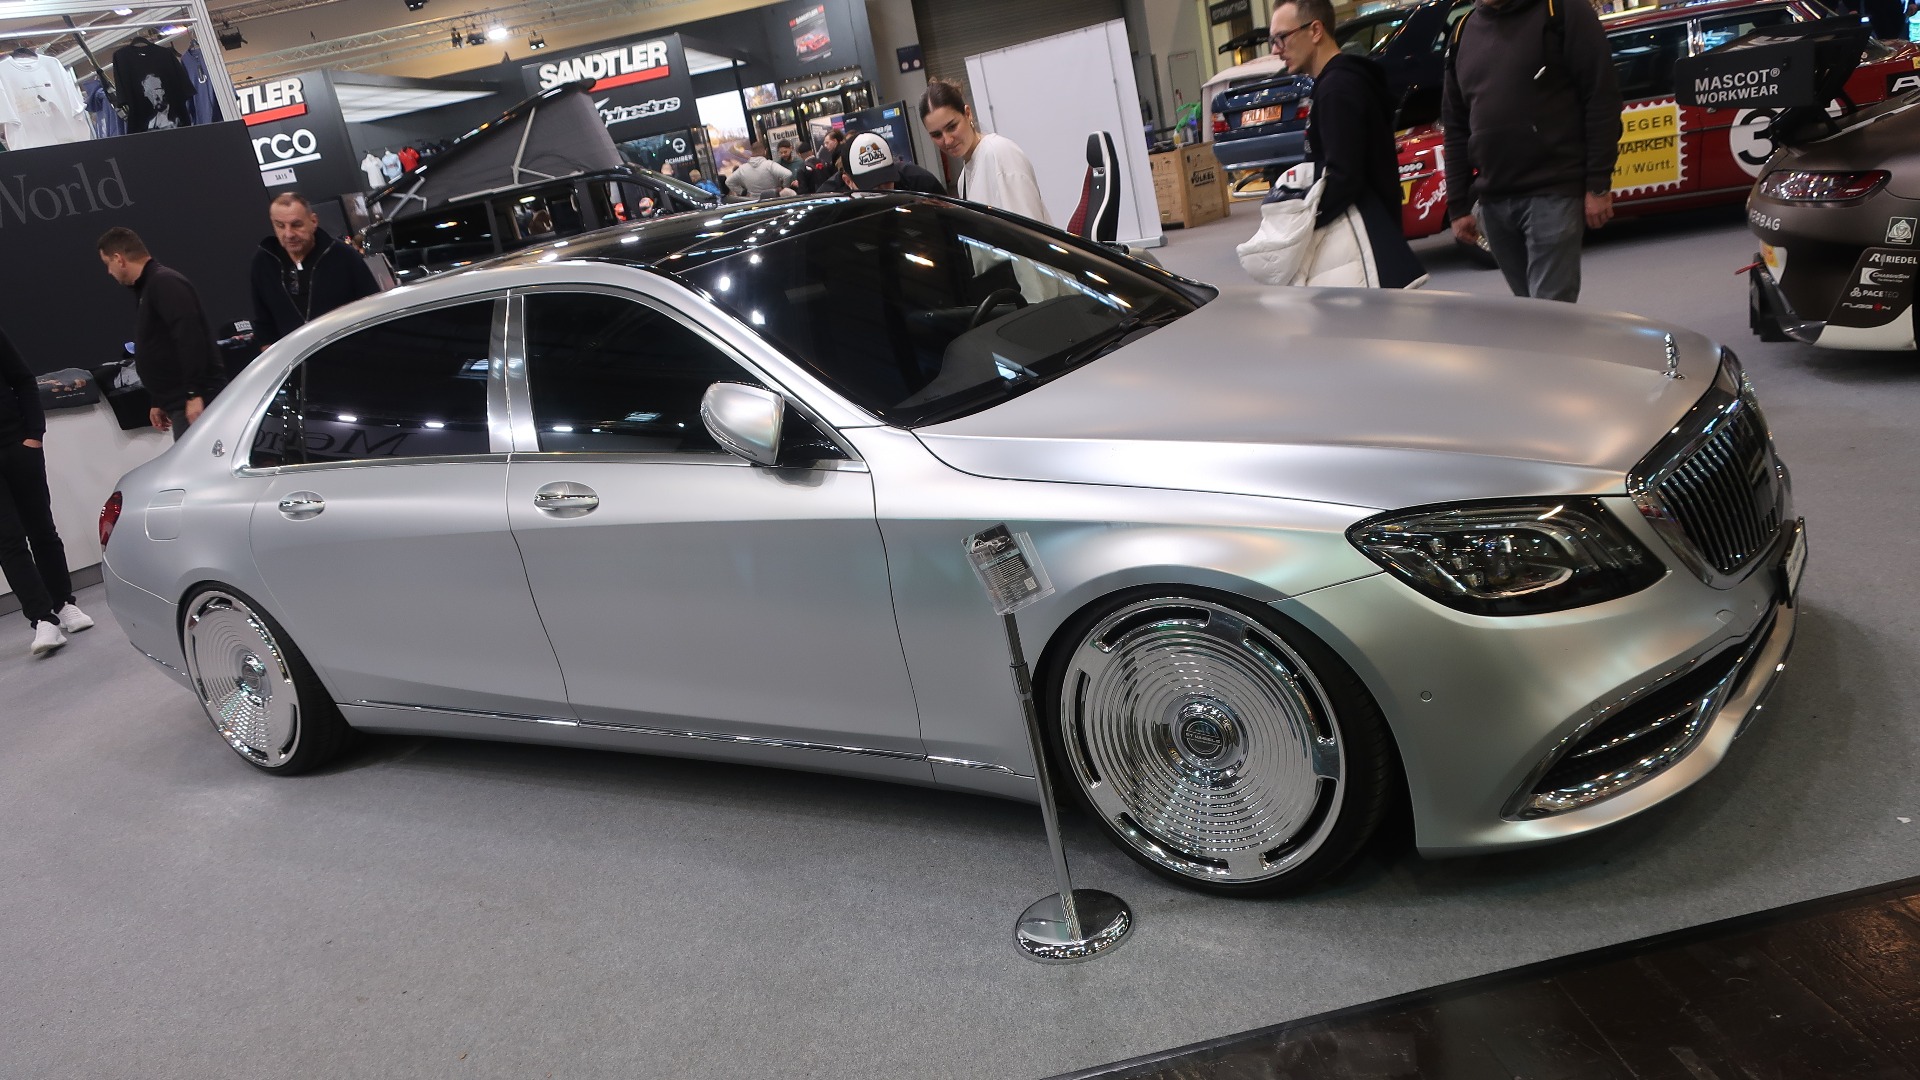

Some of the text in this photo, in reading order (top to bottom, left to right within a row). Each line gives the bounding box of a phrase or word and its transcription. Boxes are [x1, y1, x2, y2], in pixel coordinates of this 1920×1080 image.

[539, 40, 668, 90] SANDTLER
[237, 78, 304, 115] TLER
[1695, 84, 1779, 105] WORKWEAR
[1632, 159, 1675, 174] Württ.
[1885, 255, 1918, 265] RIEDEL
